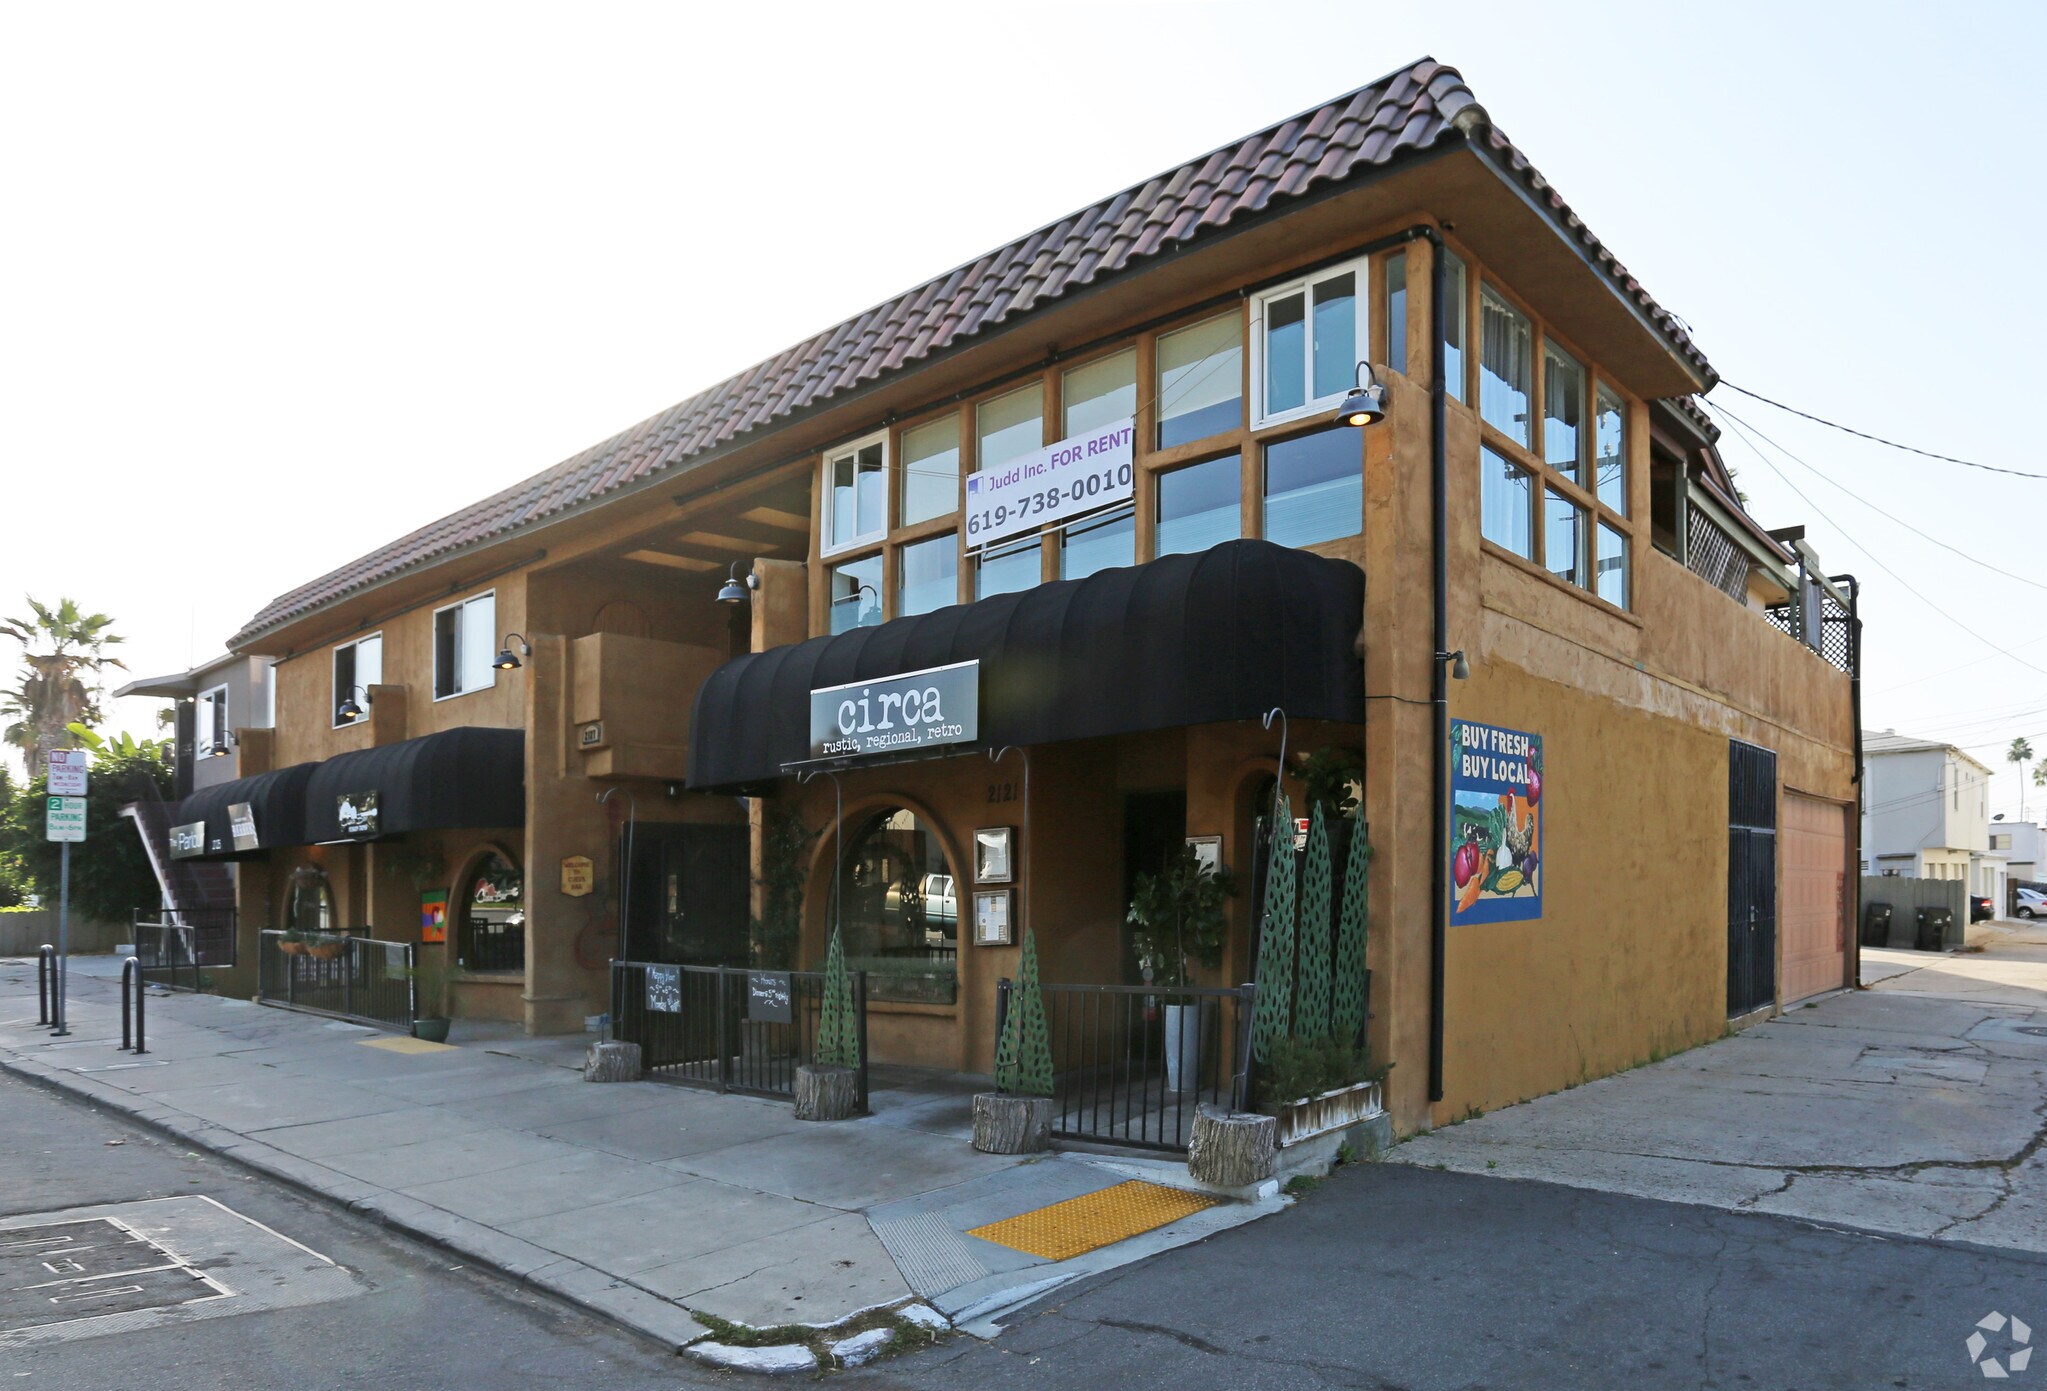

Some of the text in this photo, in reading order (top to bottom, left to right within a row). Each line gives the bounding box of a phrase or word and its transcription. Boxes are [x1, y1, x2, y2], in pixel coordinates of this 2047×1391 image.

[989, 427, 1131, 492] Judd Inc. FOR RENT
[967, 463, 1132, 535] 619-738-0010
[837, 686, 945, 736] circa
[822, 723, 963, 755] rustic, regional, retro
[1462, 724, 1529, 758] BUY FRESH
[50, 751, 65, 762] NO
[52, 765, 84, 774] PARKING
[1462, 754, 1531, 785] BUY LOCAL
[51, 799, 83, 810] 2 HOUR
[987, 782, 1018, 804] 2121
[51, 813, 83, 822] PARKING
